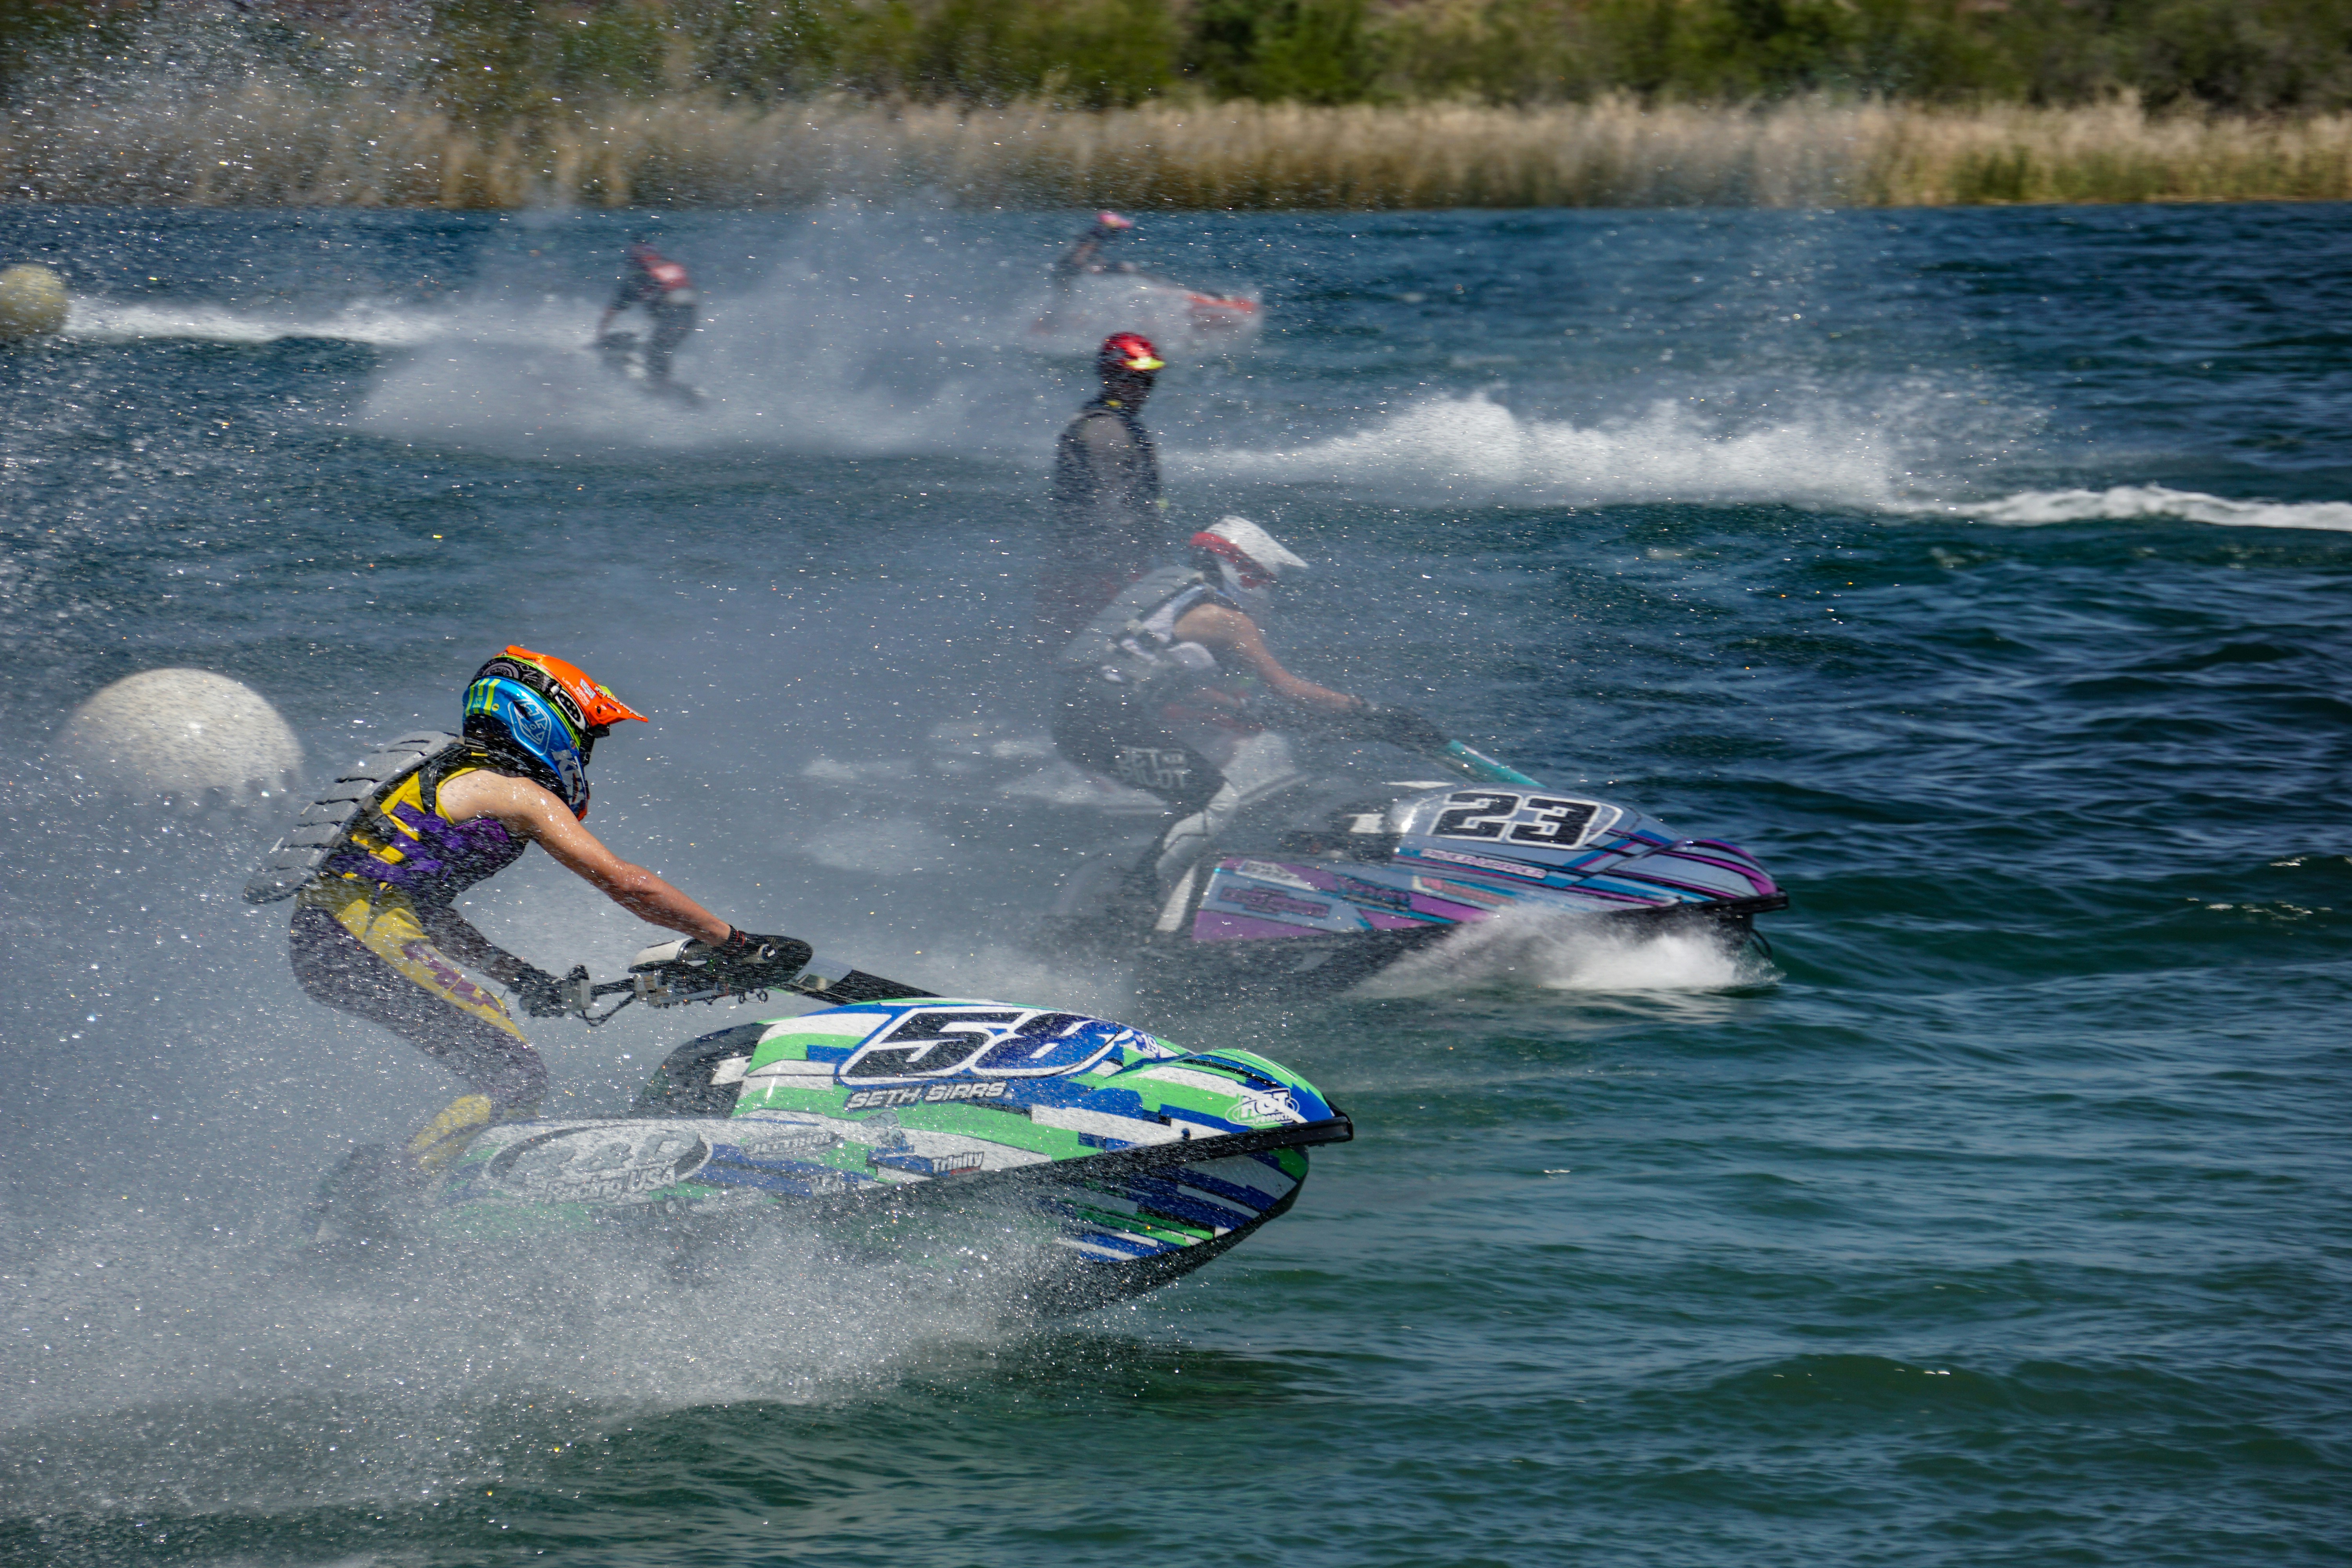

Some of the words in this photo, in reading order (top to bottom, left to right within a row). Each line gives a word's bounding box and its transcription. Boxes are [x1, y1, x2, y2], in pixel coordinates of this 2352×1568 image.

[1431, 791, 1600, 848] 23
[848, 1088, 921, 1108] SETH
[932, 1152, 983, 1173] Trinity
[628, 1166, 677, 1193] USA
